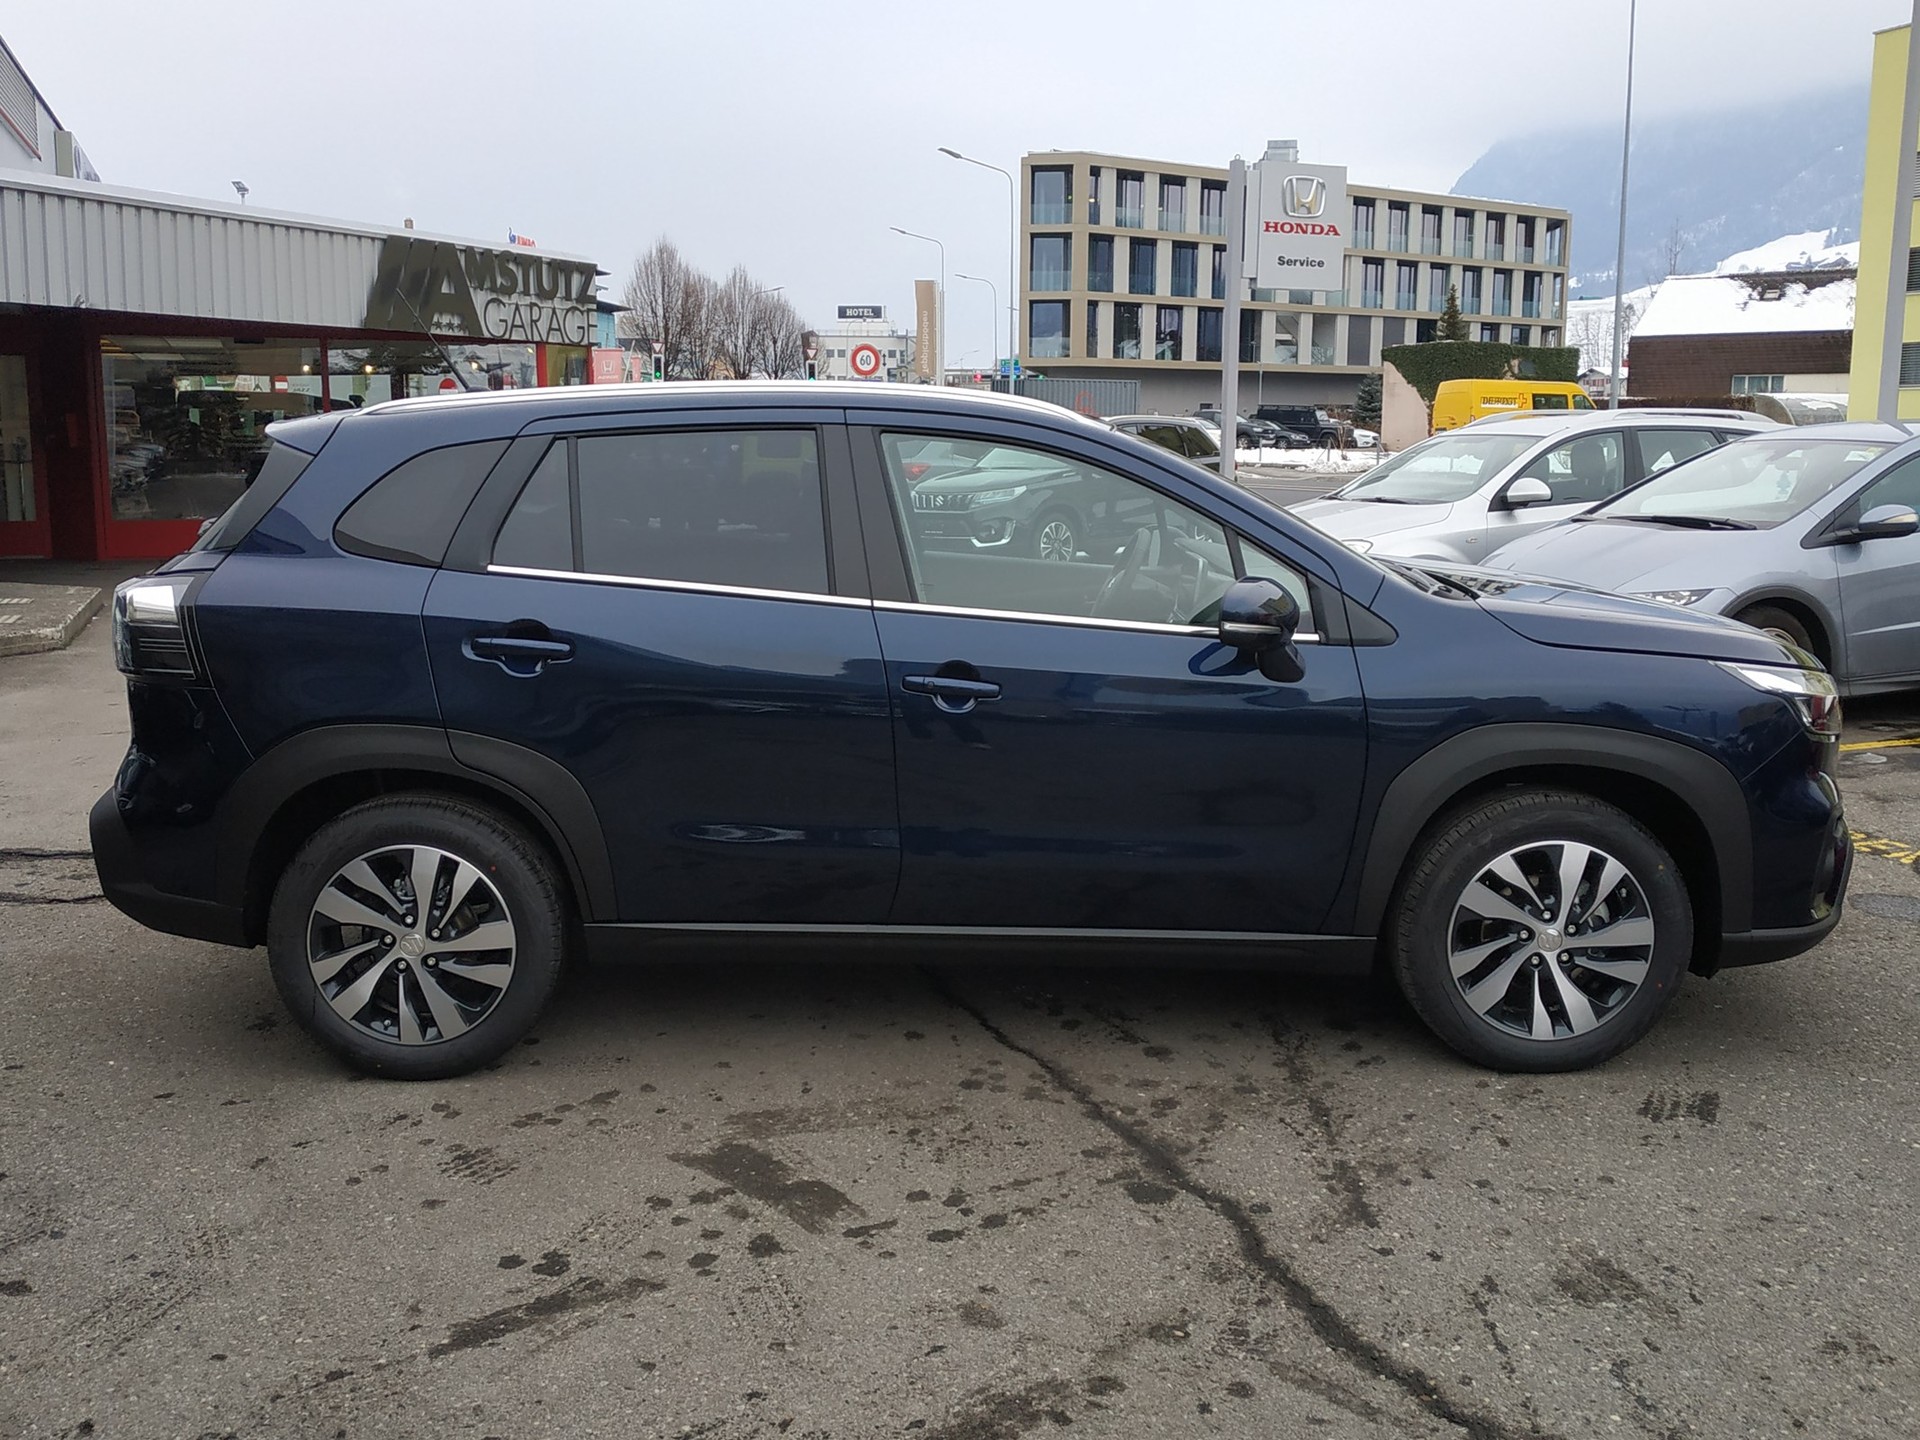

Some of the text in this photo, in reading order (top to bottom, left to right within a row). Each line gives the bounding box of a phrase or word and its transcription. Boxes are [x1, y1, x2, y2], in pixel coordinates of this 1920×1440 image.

[1263, 220, 1341, 237] HONDA
[1277, 255, 1325, 268] Service
[846, 308, 874, 316] HOTEL
[483, 297, 599, 346] GARAGE
[860, 355, 872, 366] 60
